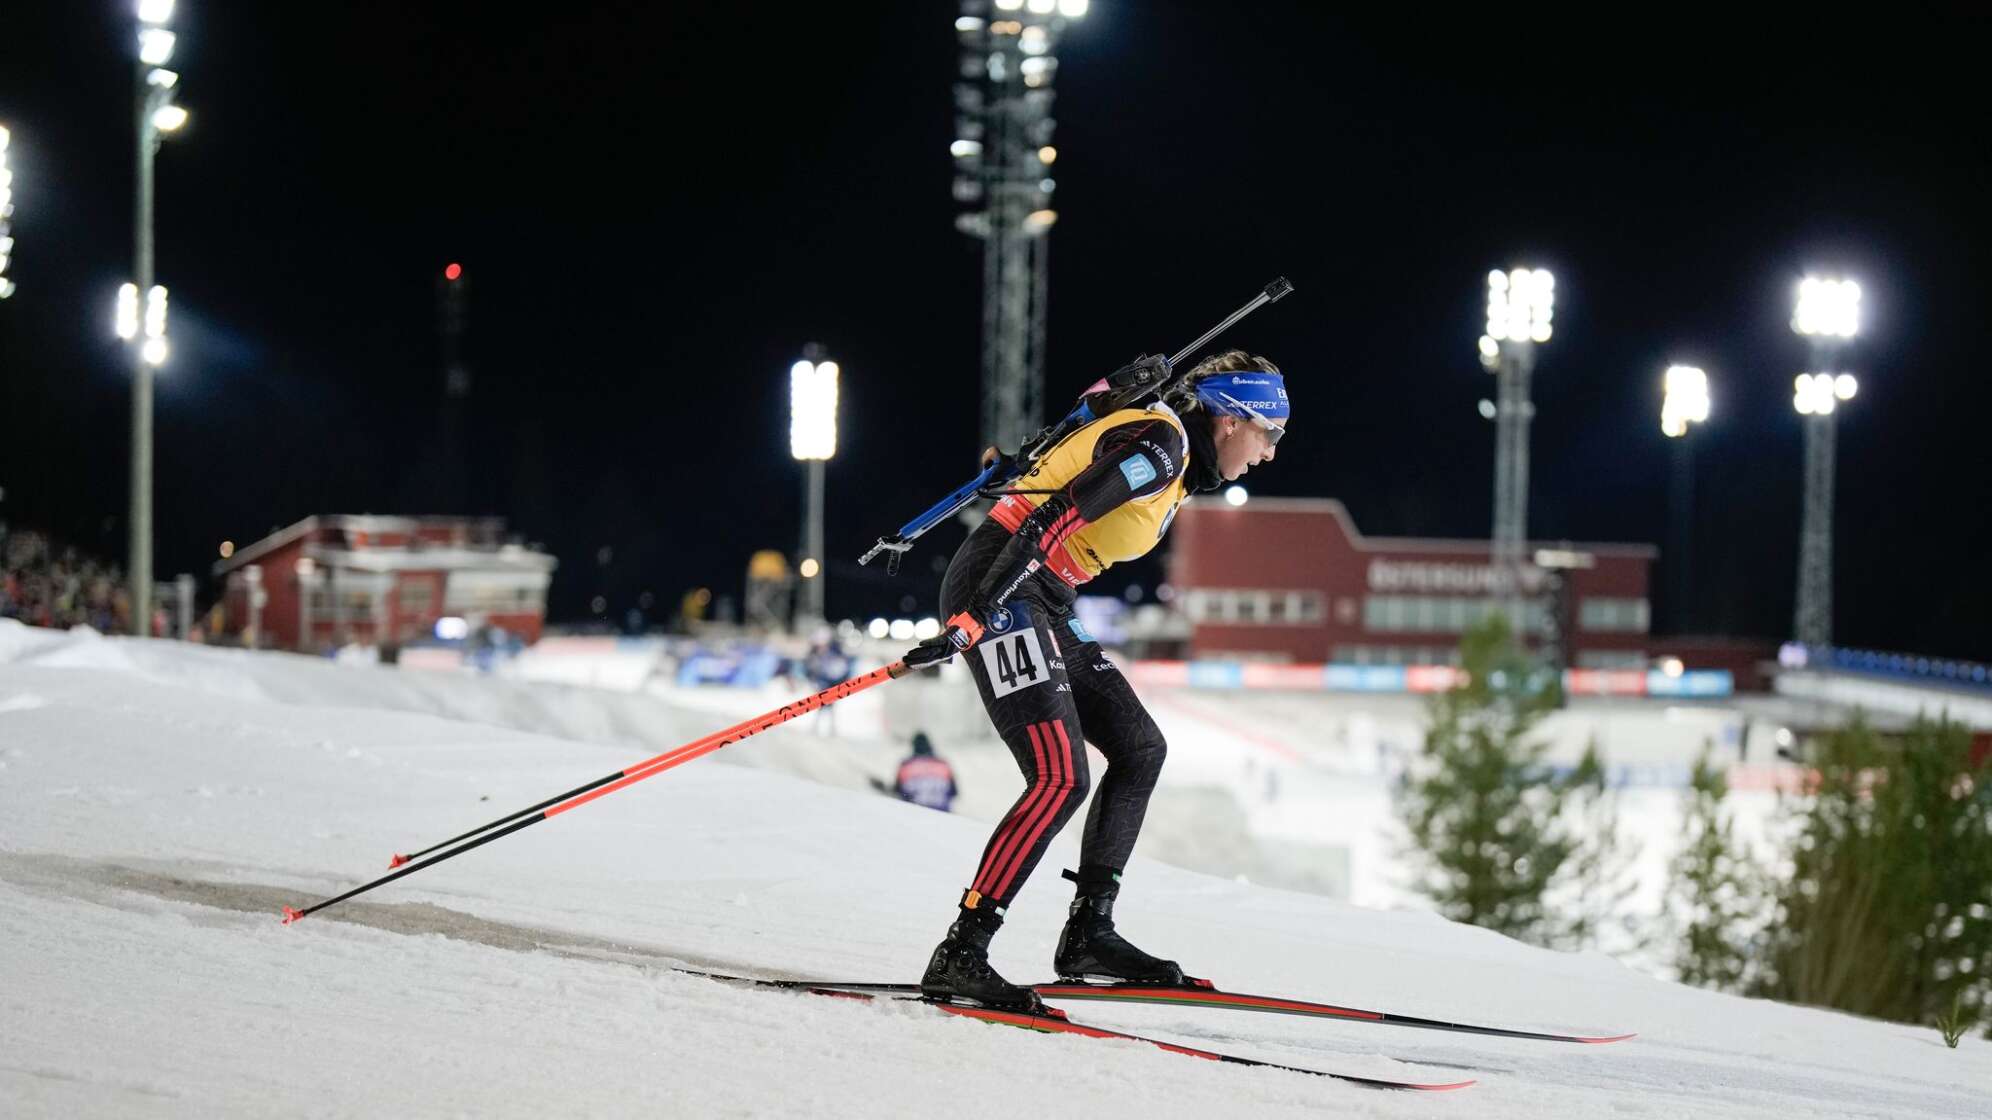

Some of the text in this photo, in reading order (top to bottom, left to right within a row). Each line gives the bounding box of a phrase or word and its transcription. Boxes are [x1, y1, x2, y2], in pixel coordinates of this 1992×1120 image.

[1151, 443, 1174, 479] TERREX
[997, 569, 1031, 605] Kaufland
[995, 634, 1037, 688] 44
